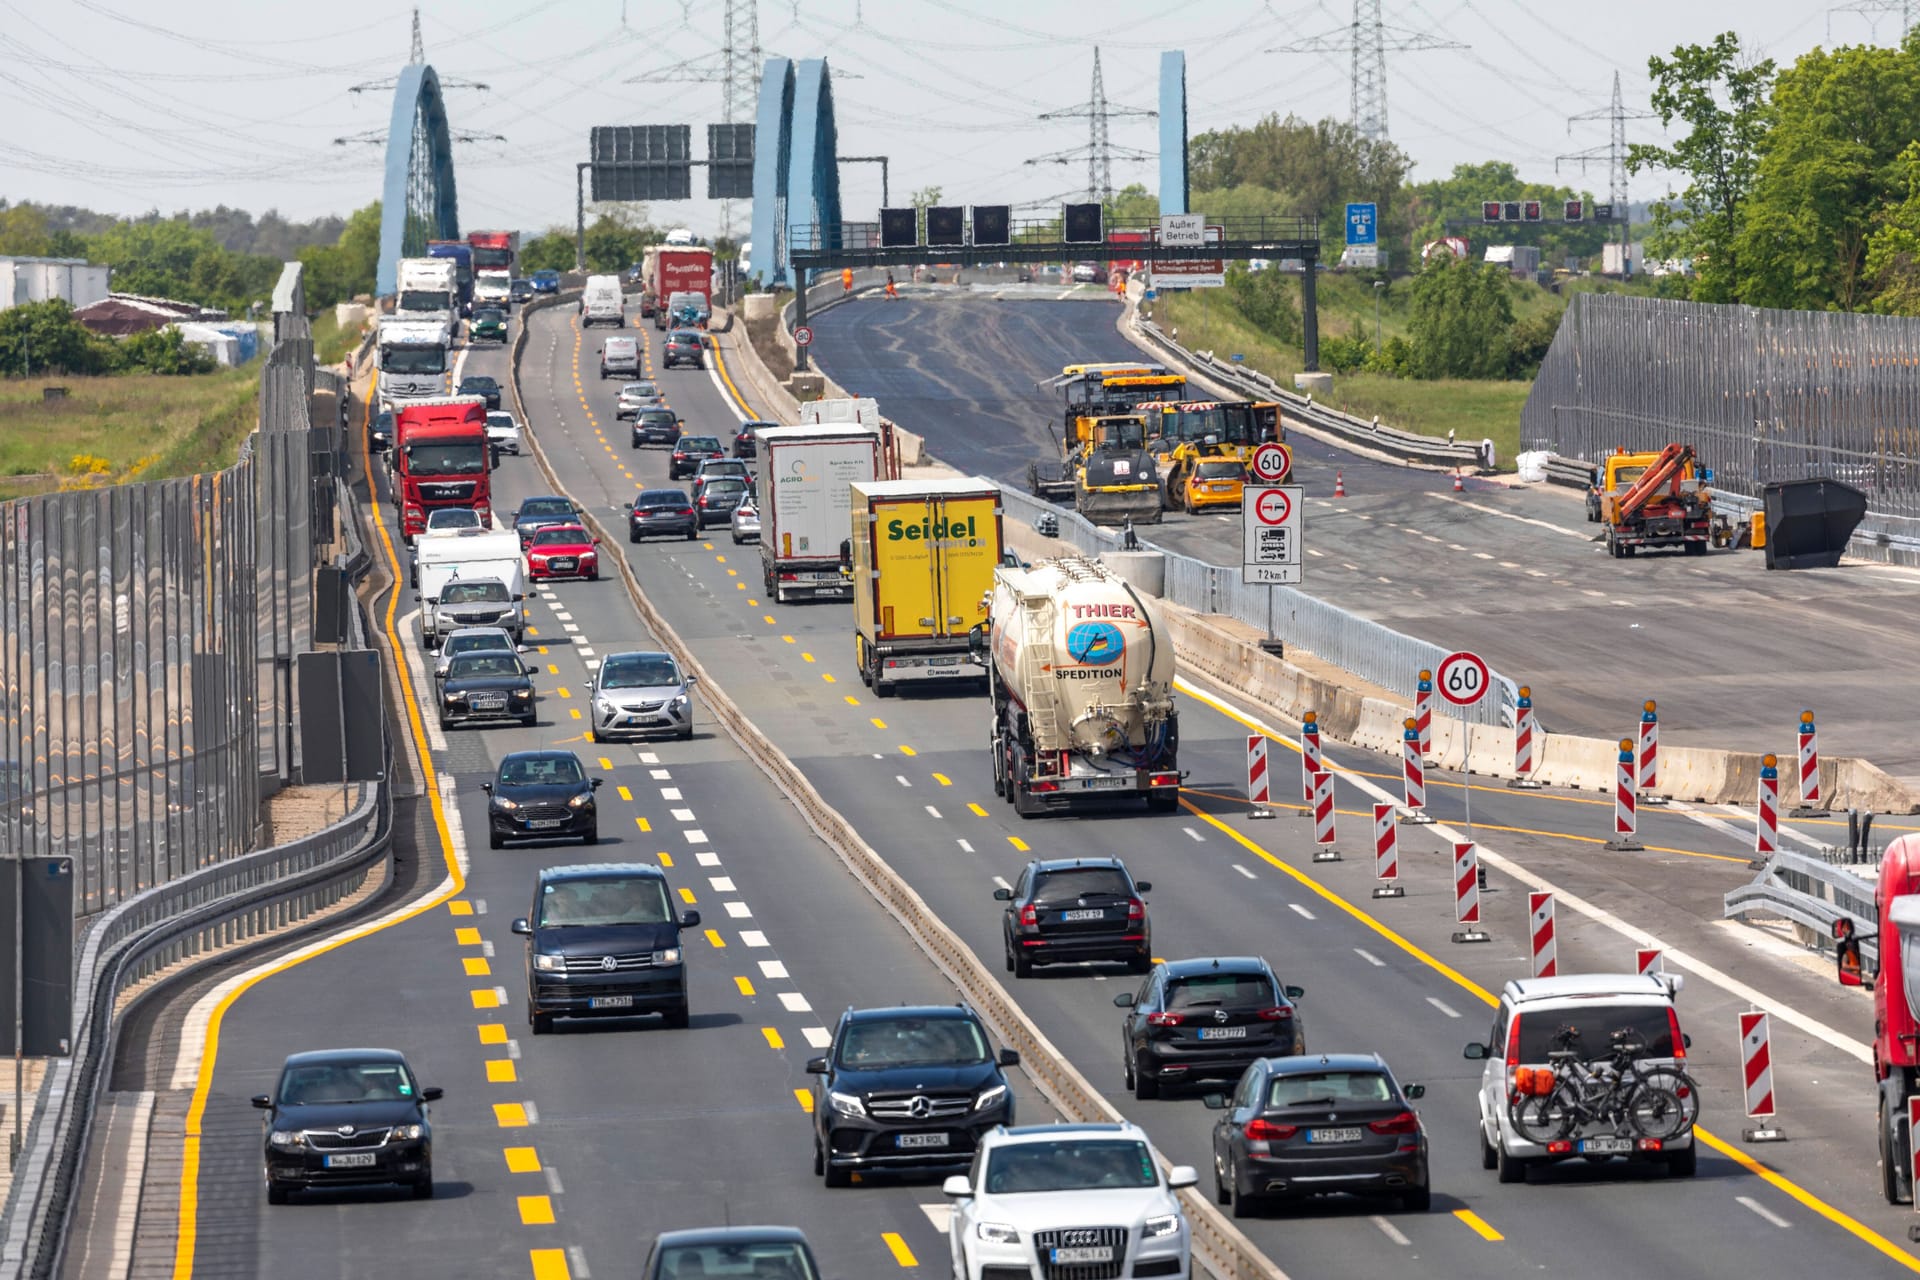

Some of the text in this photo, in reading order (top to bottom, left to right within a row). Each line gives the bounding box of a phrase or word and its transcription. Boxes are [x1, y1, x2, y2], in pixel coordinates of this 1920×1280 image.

[1169, 220, 1196, 229] Außer
[1166, 231, 1199, 240] Betrieb
[1261, 454, 1281, 470] 60
[888, 516, 976, 541] Seidel
[1071, 604, 1136, 618] THIER
[1055, 668, 1122, 679] SPEDITION
[1449, 667, 1478, 691] 60
